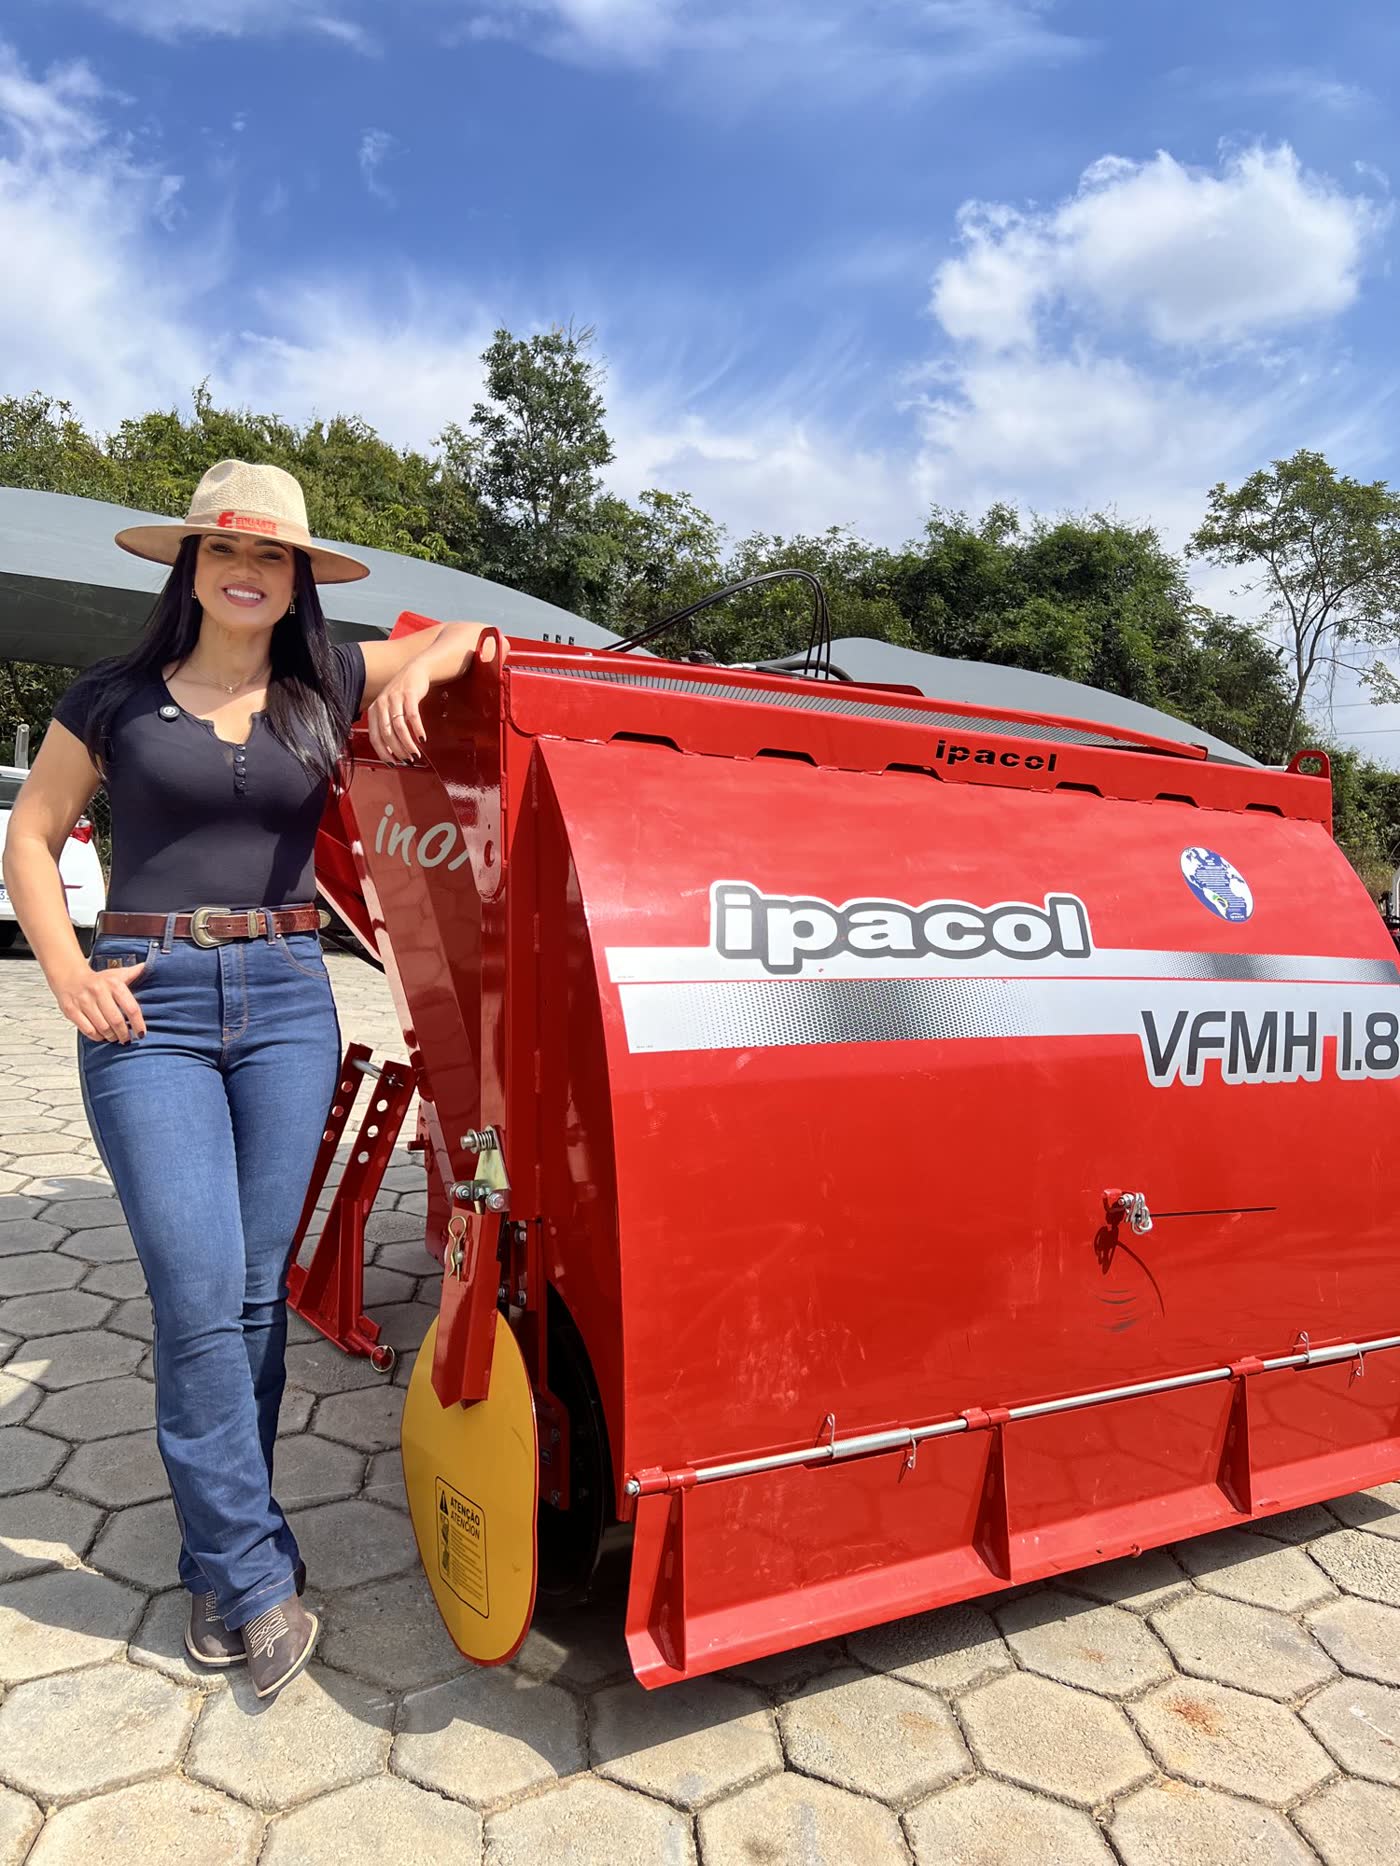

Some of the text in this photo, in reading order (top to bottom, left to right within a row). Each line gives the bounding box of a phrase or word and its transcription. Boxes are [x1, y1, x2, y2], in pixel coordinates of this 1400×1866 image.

[936, 739, 1057, 772] ipacol
[716, 885, 1091, 975] ipacol
[1141, 1010, 1317, 1076] VFMH
[450, 1496, 480, 1526] ATENÇÃO
